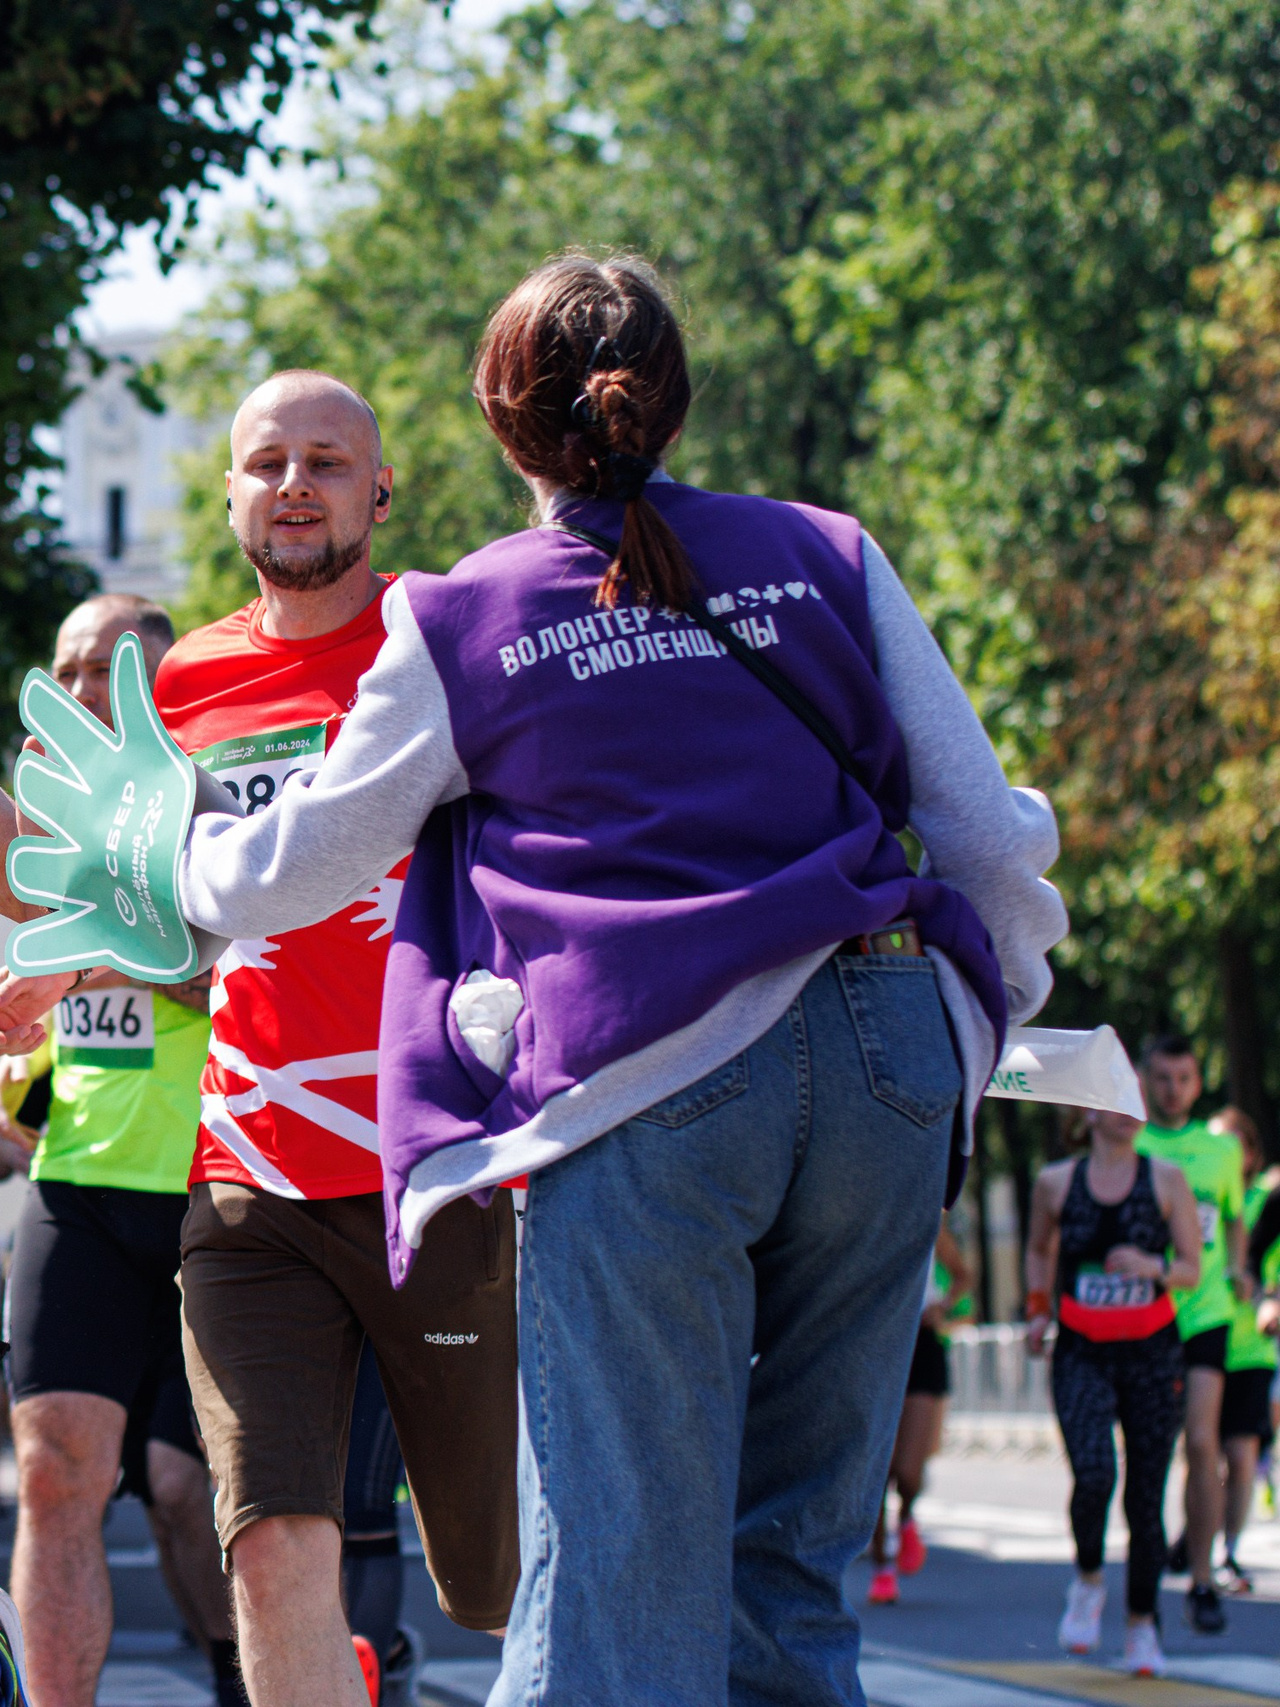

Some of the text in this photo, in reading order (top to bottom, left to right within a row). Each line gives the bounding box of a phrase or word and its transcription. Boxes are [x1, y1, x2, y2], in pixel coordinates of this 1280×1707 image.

[498, 605, 651, 677] ВОЛОНТЕР
[568, 615, 780, 681] СМОЛЕНЩНЫ
[264, 739, 311, 753] 01.06.2024
[105, 780, 136, 878] СБЕР
[131, 834, 154, 925] зелёный
[138, 845, 167, 938] марафон
[60, 996, 141, 1038] 0346
[424, 1332, 465, 1345] adidas
